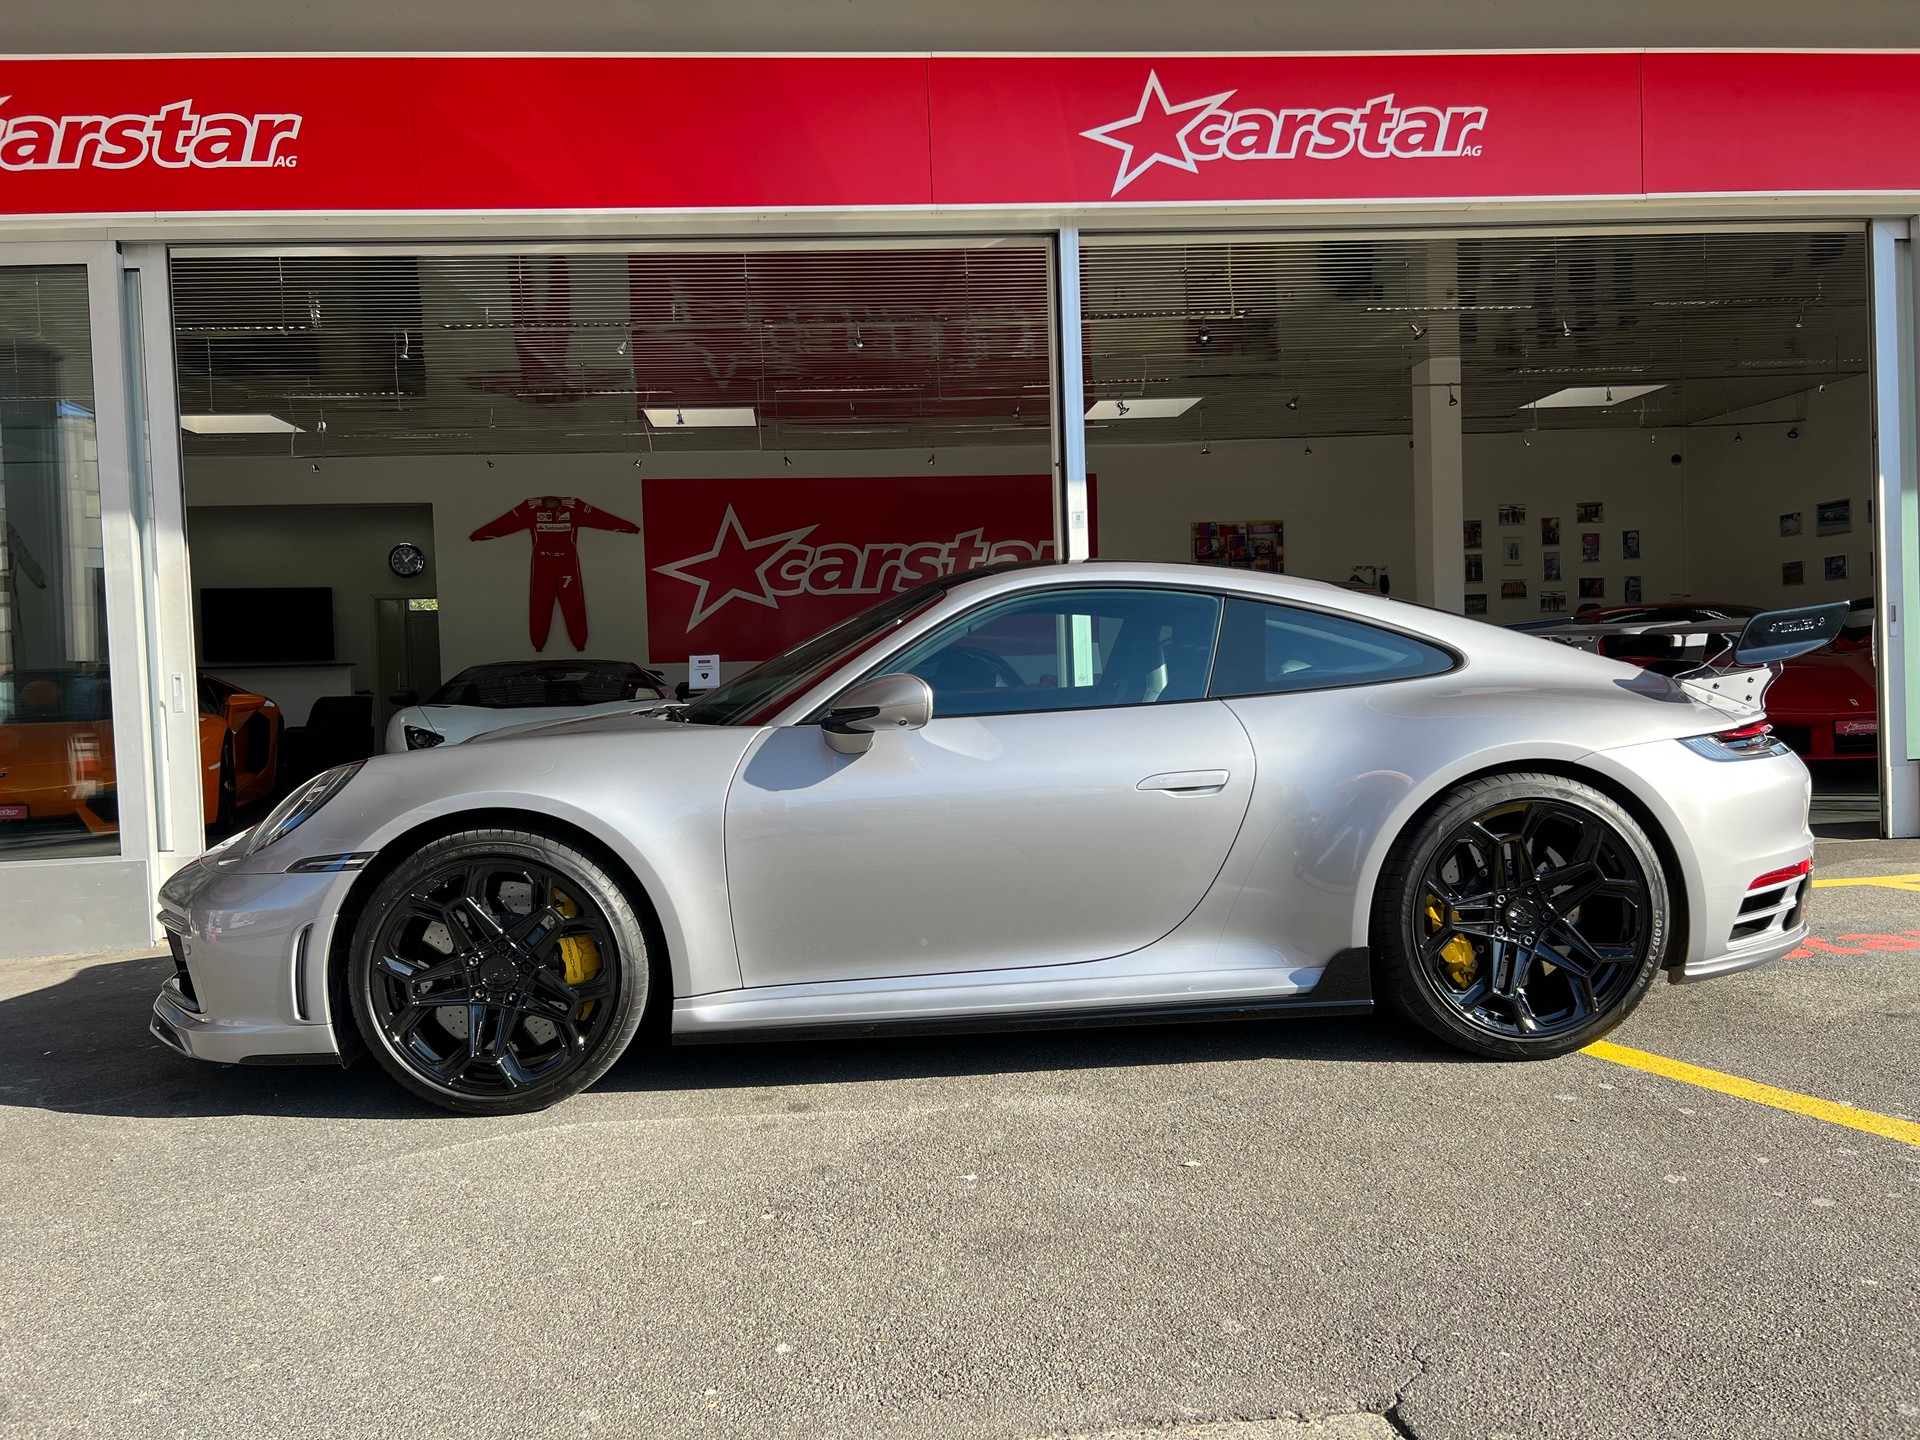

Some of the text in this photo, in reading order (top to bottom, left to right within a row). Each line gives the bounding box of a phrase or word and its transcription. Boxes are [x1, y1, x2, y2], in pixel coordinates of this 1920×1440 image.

[0, 99, 302, 170] arstar AG
[1184, 93, 1488, 160] carstar AG
[562, 575, 573, 588] 7
[772, 527, 1054, 595] carst
[565, 939, 578, 978] ORSCHE
[1636, 909, 1663, 988] GOODYEAR
